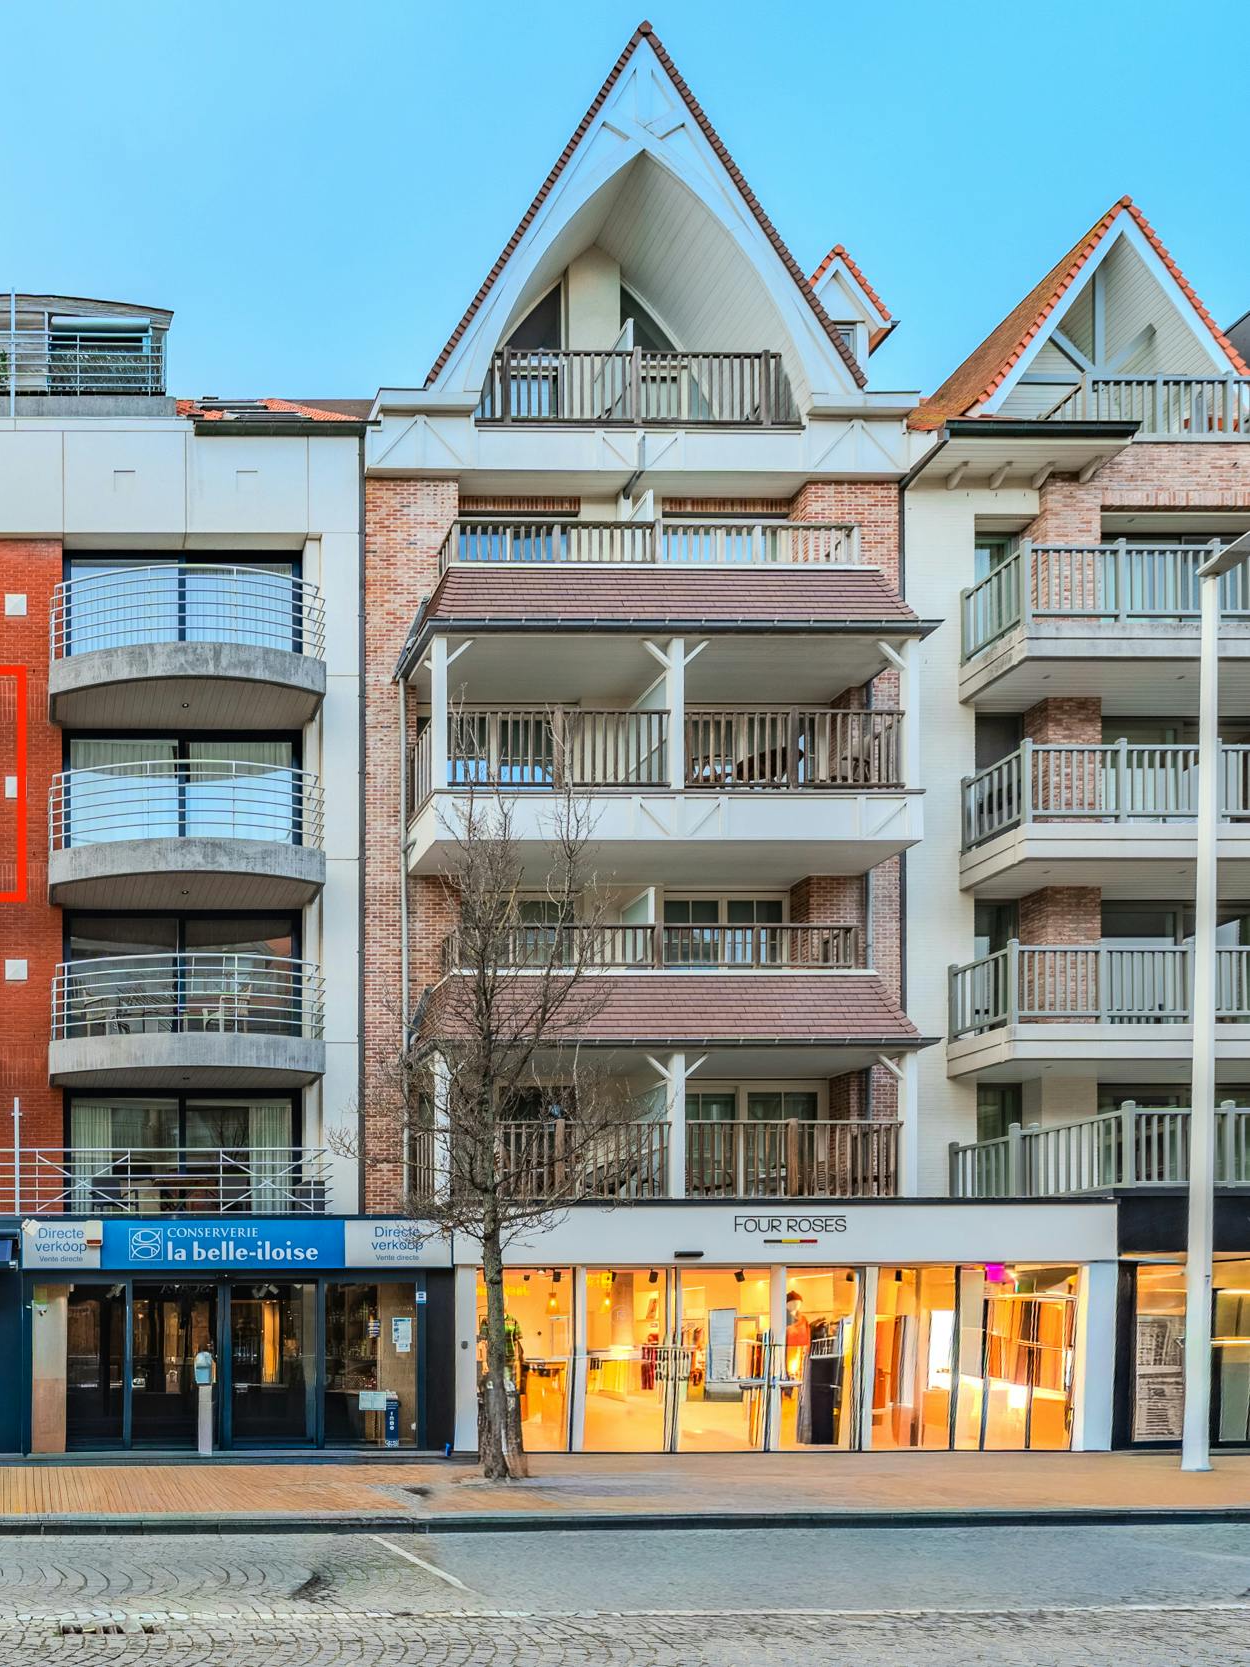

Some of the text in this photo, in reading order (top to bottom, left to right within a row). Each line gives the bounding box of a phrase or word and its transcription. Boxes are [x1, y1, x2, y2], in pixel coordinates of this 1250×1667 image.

[734, 1215, 847, 1232] FOUR ROSES
[38, 1227, 85, 1239] Directe
[167, 1227, 259, 1238] CONSERVERIE
[374, 1226, 421, 1238] Directe
[34, 1240, 87, 1255] verkoop
[167, 1241, 319, 1261] la belle-iloise
[371, 1239, 424, 1253] verkoop
[38, 1255, 84, 1263] Vente directe
